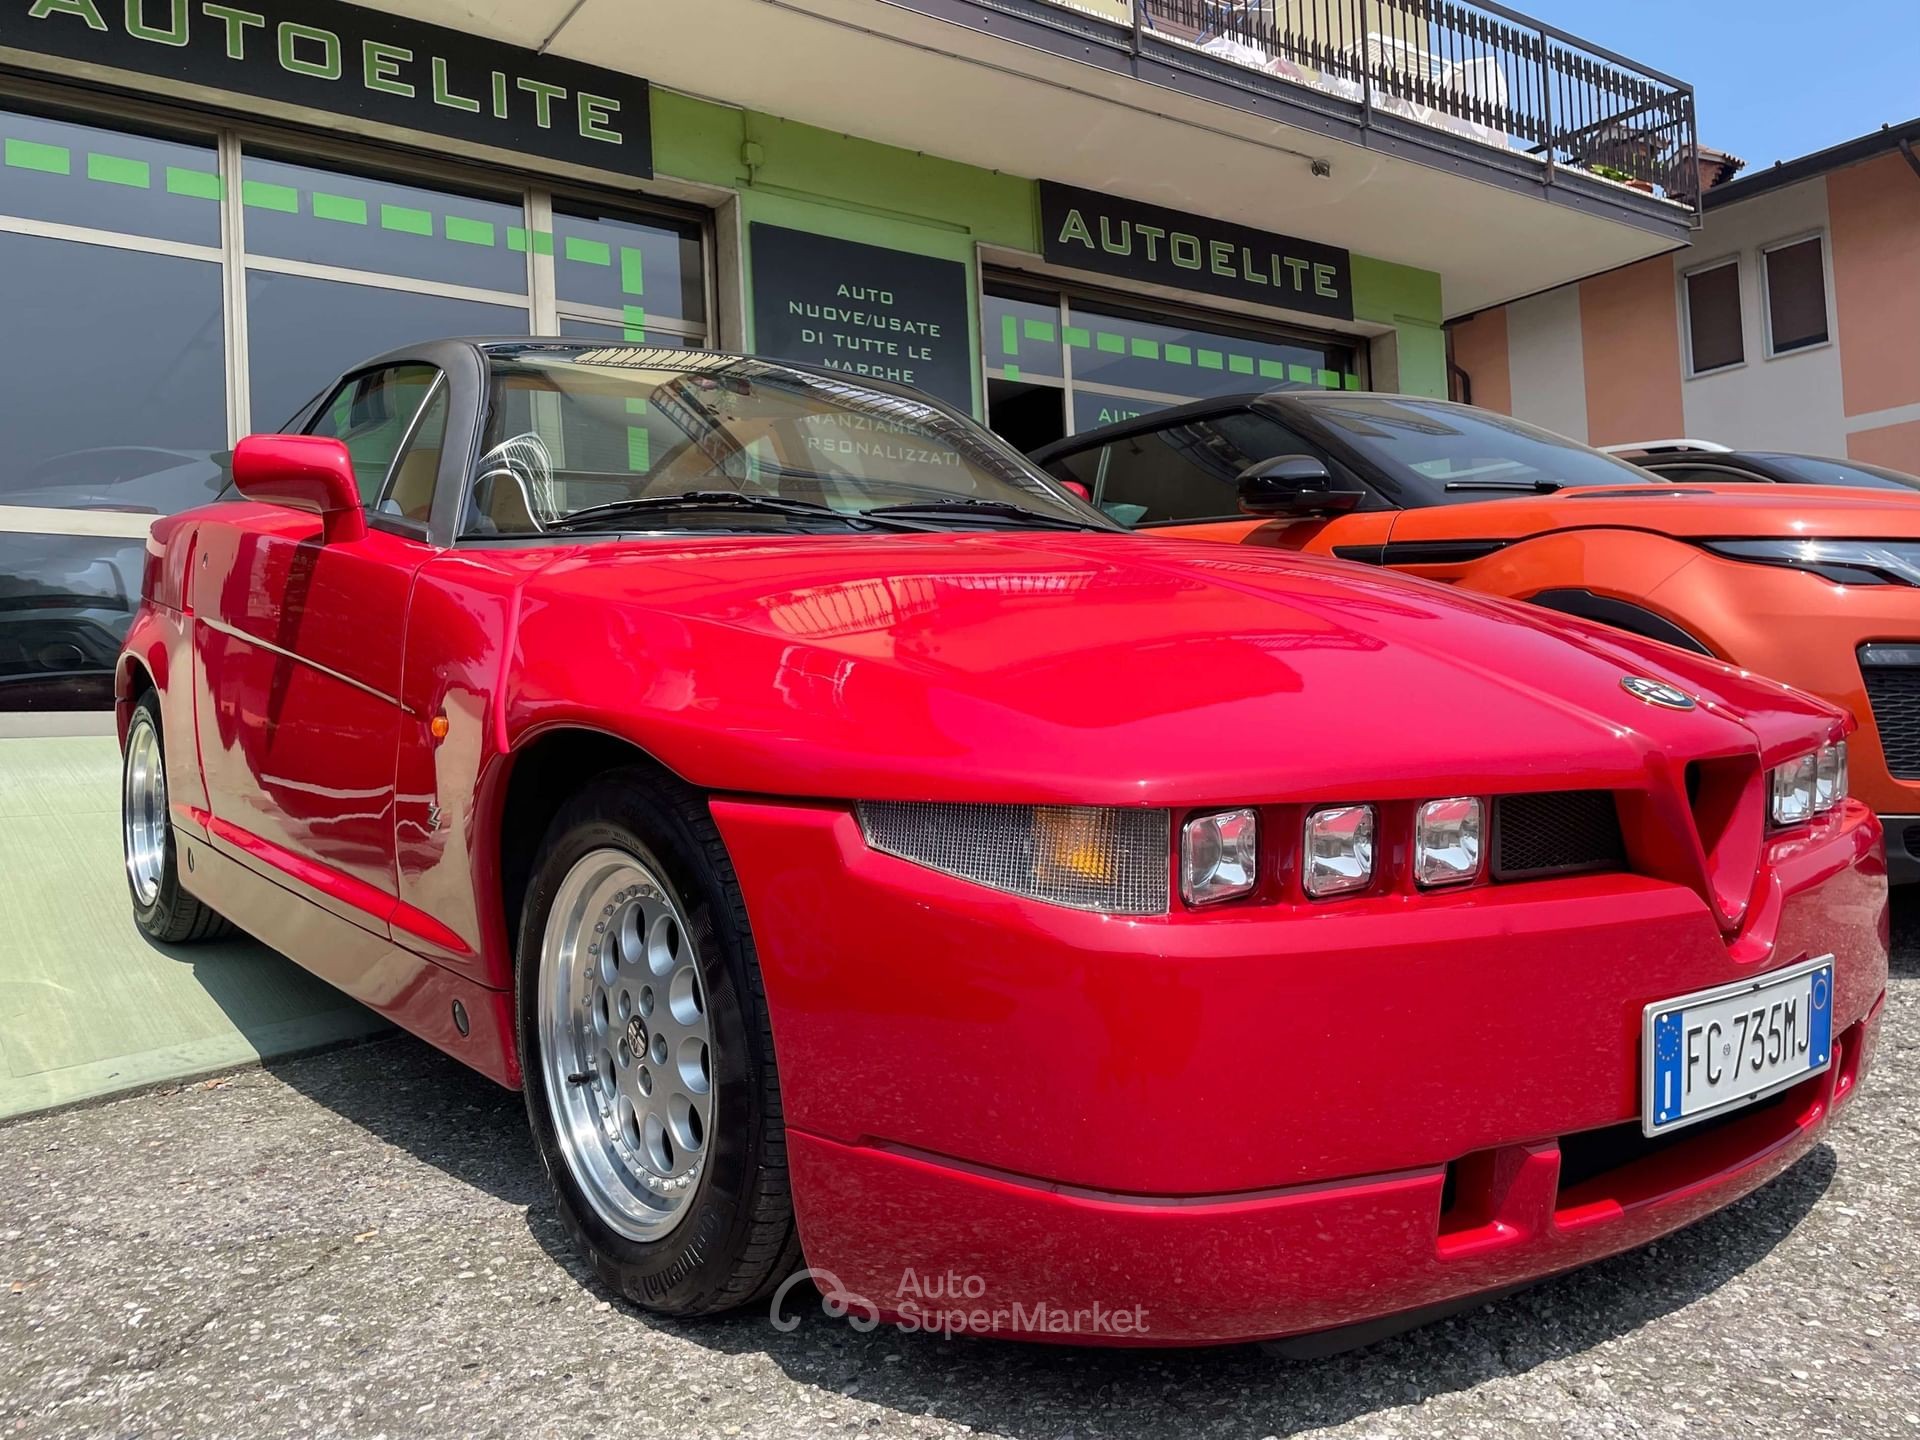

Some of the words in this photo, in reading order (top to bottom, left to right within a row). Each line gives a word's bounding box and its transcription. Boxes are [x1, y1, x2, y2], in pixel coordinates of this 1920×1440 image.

[1058, 209, 1338, 298] AUTOELITE
[836, 284, 894, 305] AUTO
[789, 301, 941, 338] NUOVE/USATE
[802, 329, 824, 345] DI
[833, 334, 898, 356] TUTTE
[908, 346, 932, 361] LE
[824, 358, 914, 383] MARCHE
[1687, 1022, 1722, 1095] FC
[1733, 993, 1811, 1081] 735MJ
